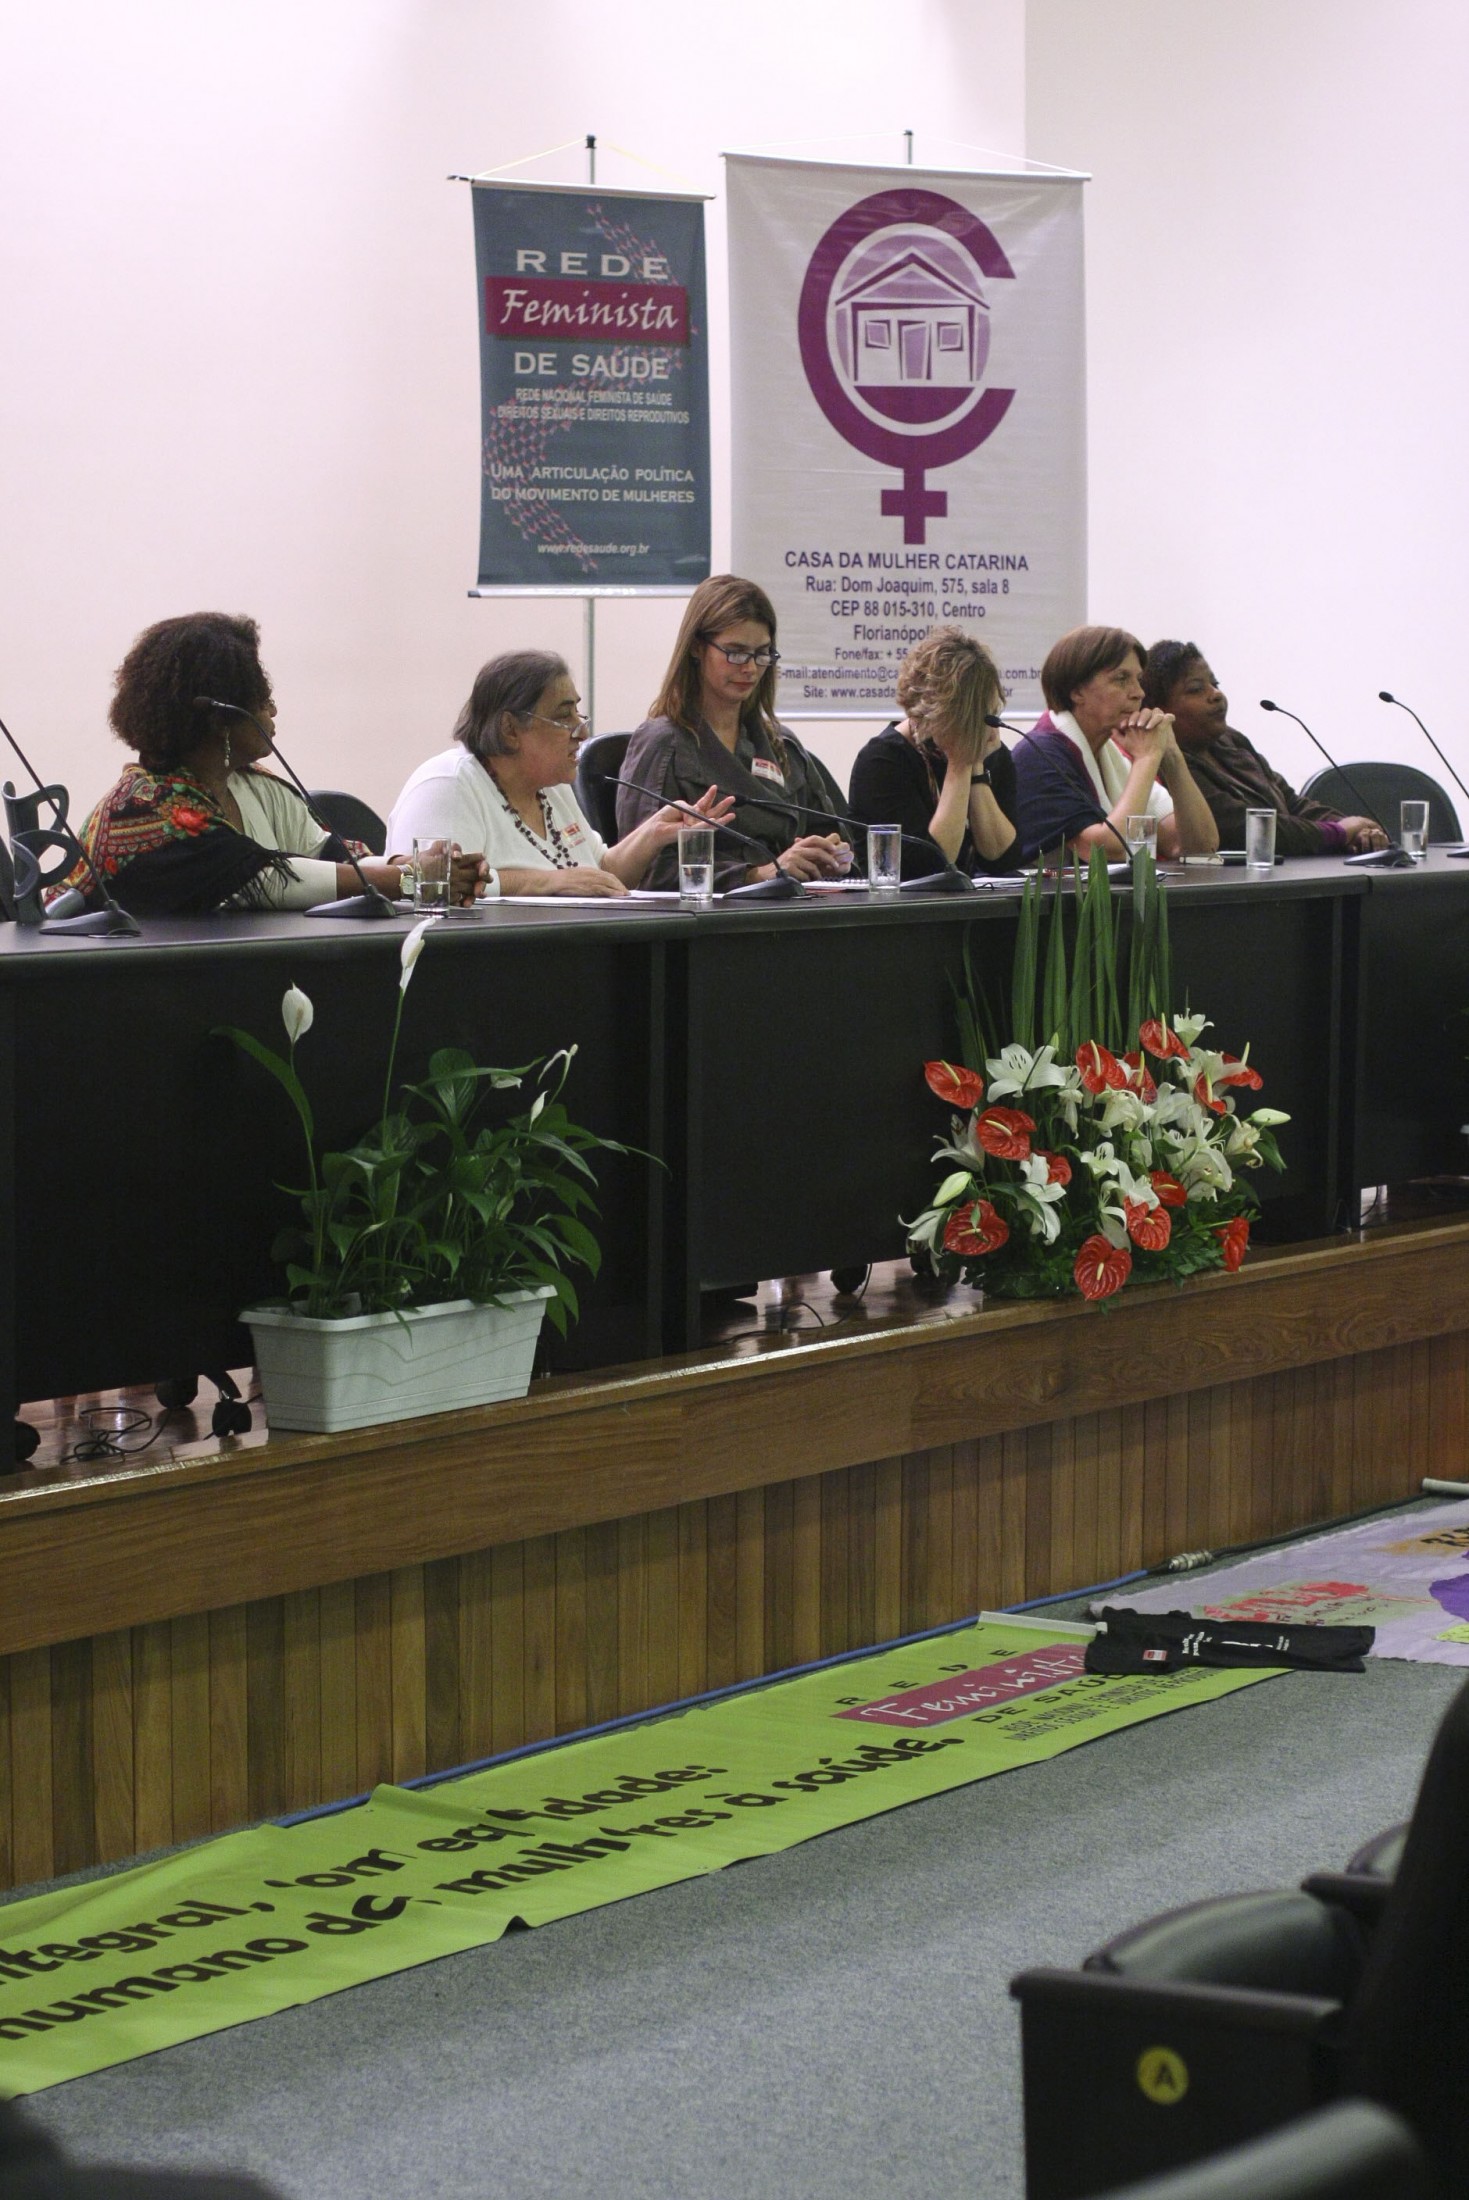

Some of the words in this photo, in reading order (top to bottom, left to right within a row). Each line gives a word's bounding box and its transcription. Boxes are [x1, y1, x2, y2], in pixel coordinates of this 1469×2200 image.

[516, 249, 669, 280] REDE
[500, 288, 679, 331] Feminista
[514, 352, 557, 375] DE
[571, 350, 670, 380] SAÚDE
[515, 388, 541, 401] REDE
[541, 389, 586, 402] NACIONAL
[588, 390, 631, 404] FEMINISTA
[632, 392, 644, 405] DE
[497, 406, 538, 419] DIREITOS
[541, 406, 577, 420] SEXUAIS
[587, 408, 626, 422] DIREITOS
[628, 409, 690, 424] REPRODUTIVOS
[490, 463, 524, 479] UMA
[531, 464, 630, 484] ARTICULAÇÃO
[635, 466, 695, 482] POLÍTICA
[491, 487, 512, 500] DO
[514, 488, 599, 501] MOVIMENTO
[602, 489, 621, 502] DE
[623, 490, 695, 503] MULHERES
[785, 551, 833, 568] CASA
[839, 552, 863, 568] DA
[868, 552, 940, 569] MULHER
[945, 554, 1028, 571] CATARINA
[806, 575, 836, 592] Rua:
[841, 576, 872, 593] Dom
[876, 577, 938, 596] Joaquim,
[942, 578, 968, 595] 575,
[971, 578, 998, 594] sala
[1002, 578, 1009, 594] 8
[830, 601, 859, 617] CEP
[863, 601, 879, 617] 88
[883, 601, 938, 619] 015-310,
[942, 602, 986, 618] Centro
[854, 624, 933, 644] Florianópol
[835, 647, 883, 660] Fone/fax:
[803, 685, 827, 698] Site:
[830, 686, 896, 698] www.casada
[972, 1706, 1028, 1724] DE
[1033, 1674, 1128, 1704] SAÚD
[772, 1738, 965, 1793] saúde.
[1155, 2062, 1176, 2090] A
